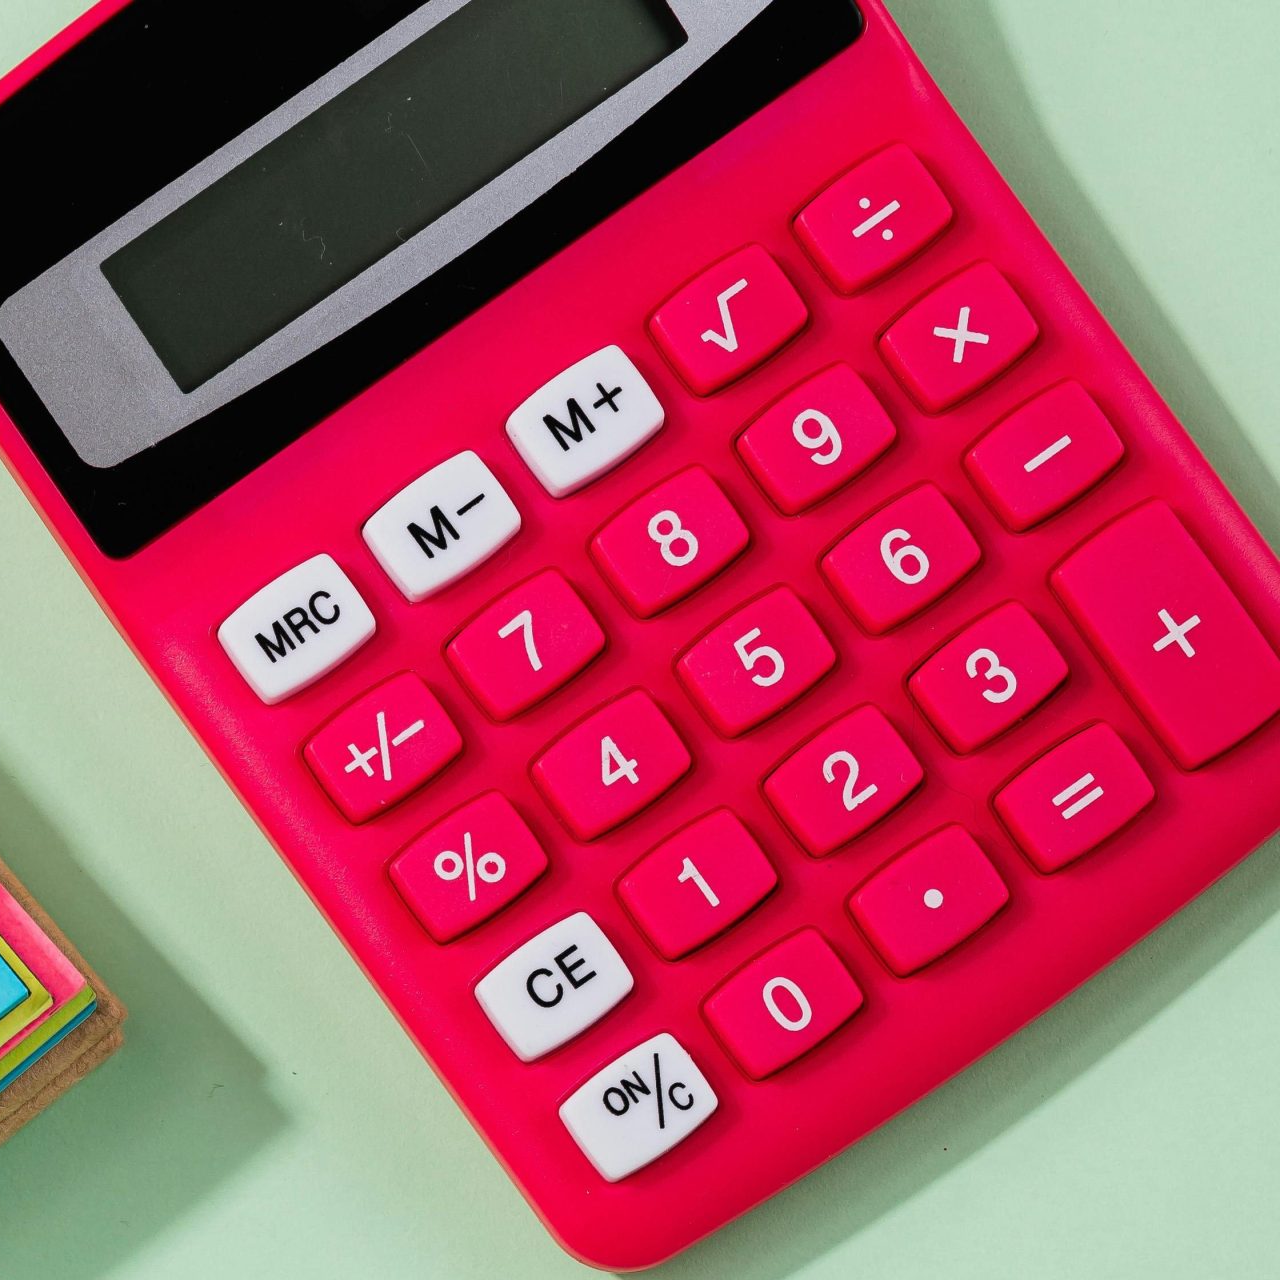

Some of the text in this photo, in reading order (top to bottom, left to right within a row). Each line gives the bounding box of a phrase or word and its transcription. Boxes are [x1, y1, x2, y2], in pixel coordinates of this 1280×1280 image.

[542, 382, 623, 452] M+
[792, 408, 843, 466] 9
[647, 509, 699, 567] 8
[880, 528, 930, 585] 6
[254, 590, 341, 664] MRC
[497, 609, 543, 672] 7
[733, 627, 785, 687] 5
[965, 648, 1017, 704] 3
[344, 711, 425, 781] +/-
[601, 735, 640, 786] 4
[822, 750, 878, 812] 2
[433, 831, 506, 902] %
[677, 857, 720, 907] 1
[526, 944, 597, 1008] CE
[762, 976, 813, 1032] 0
